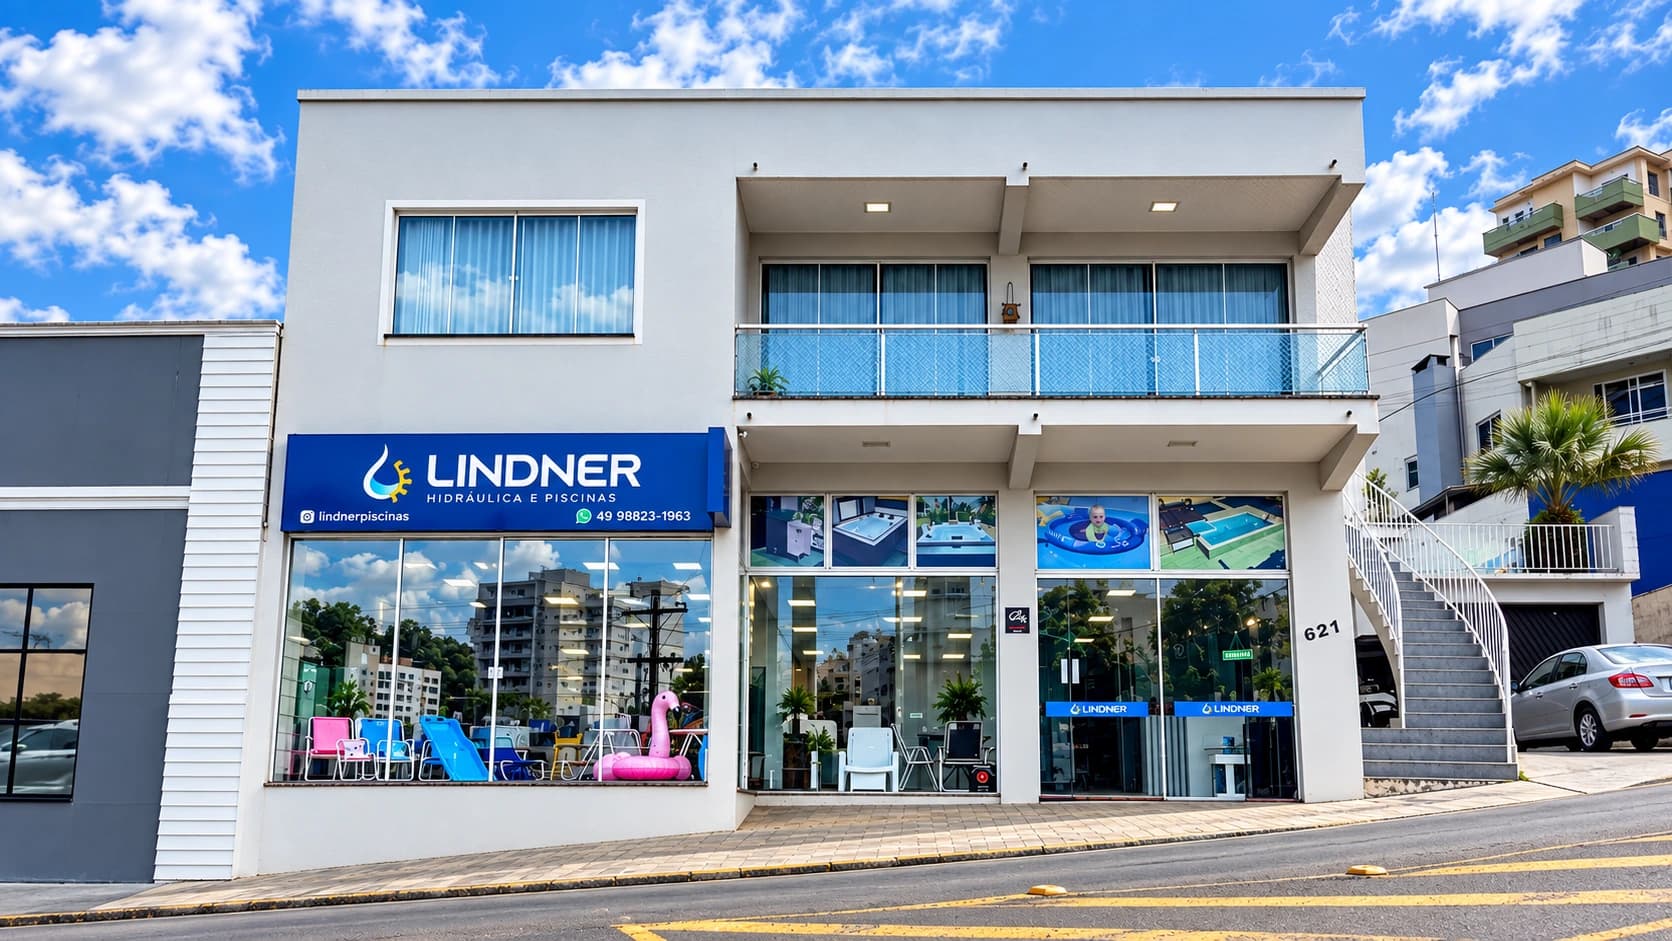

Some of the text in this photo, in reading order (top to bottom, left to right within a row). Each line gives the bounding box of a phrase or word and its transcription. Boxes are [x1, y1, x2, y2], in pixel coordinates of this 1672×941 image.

[428, 453, 641, 488] LINDNER
[426, 491, 617, 503] HIDRÁULICA E PISCINAS
[318, 510, 410, 524] lindnerpiscinas
[596, 510, 691, 522] 49 98823-1963
[1303, 619, 1340, 642] 621
[1082, 704, 1127, 714] LINDNER
[1214, 704, 1260, 714] LINDNER
